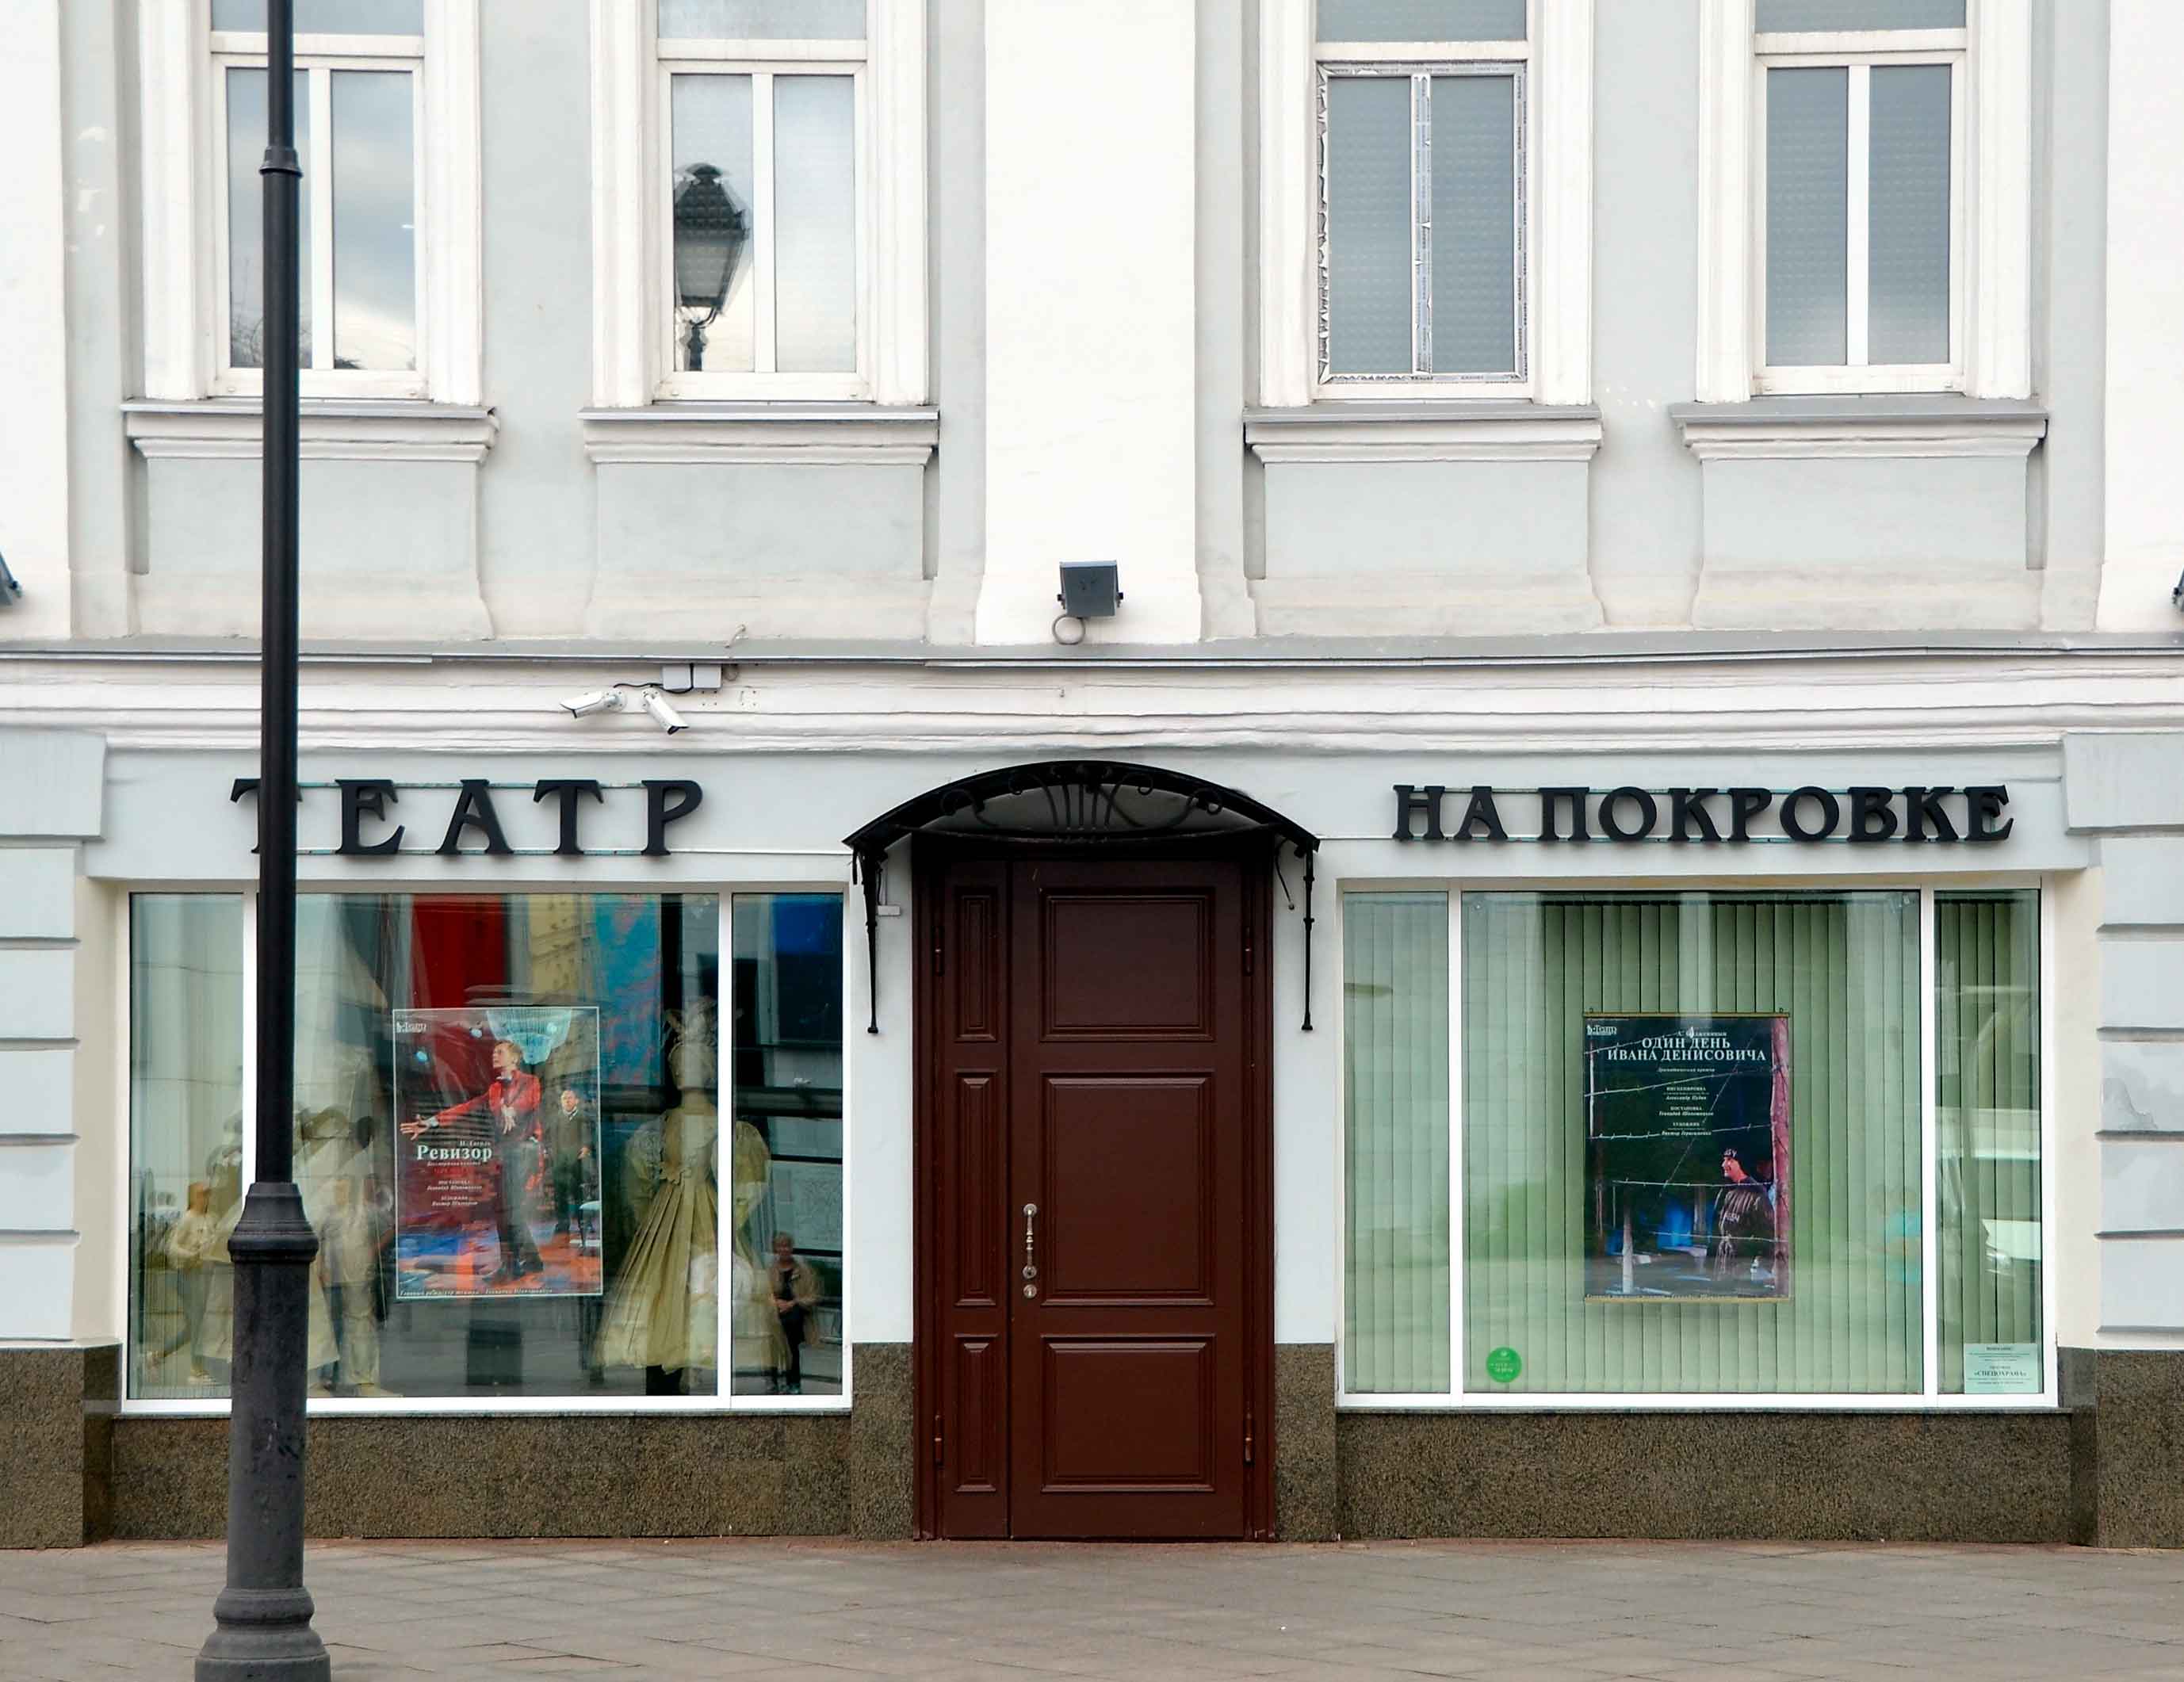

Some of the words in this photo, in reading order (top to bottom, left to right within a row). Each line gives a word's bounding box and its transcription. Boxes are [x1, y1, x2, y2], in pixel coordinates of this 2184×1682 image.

[1391, 784, 1508, 842] НА
[1538, 784, 2015, 843] ПОКРОВКЕ
[1641, 1037, 1685, 1050] ОДИН
[1689, 1037, 1731, 1050] ДЕНЬ
[1607, 1049, 1657, 1061] ИВАНА
[1661, 1049, 1766, 1062] ДЕНИСОВИЧА
[416, 1144, 492, 1163] Ревизор
